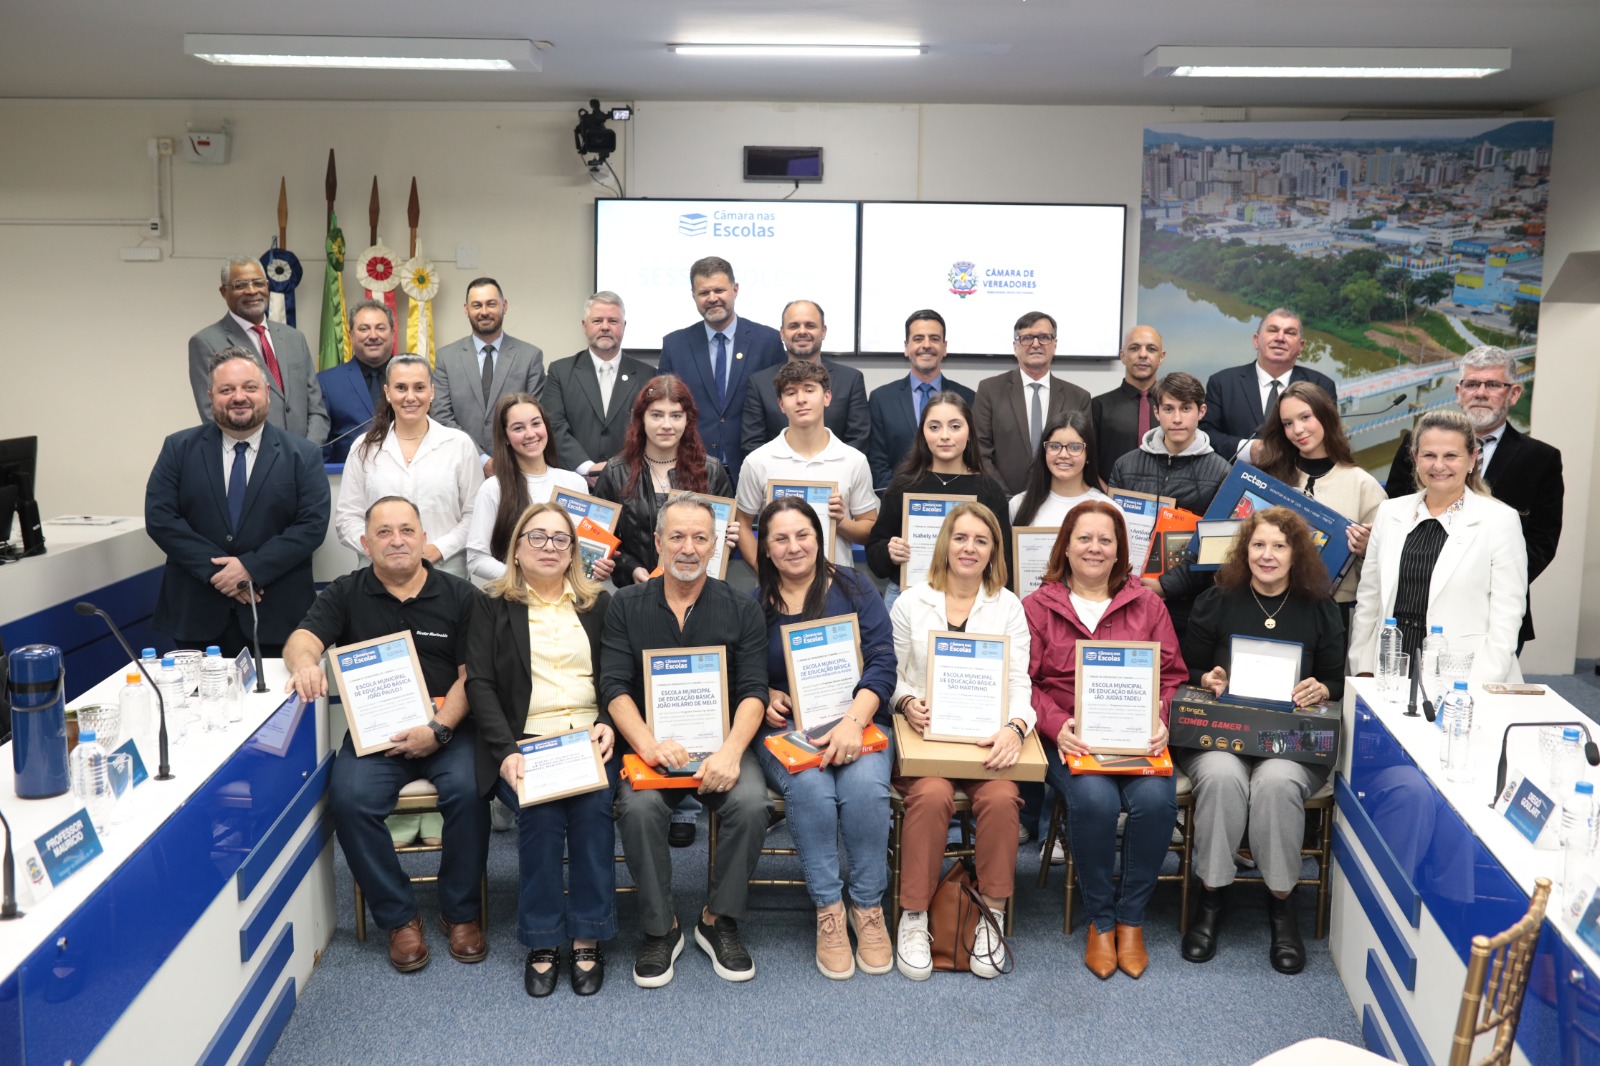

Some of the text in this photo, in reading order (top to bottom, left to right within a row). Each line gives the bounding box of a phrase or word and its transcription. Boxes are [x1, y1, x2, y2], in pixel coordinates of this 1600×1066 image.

[713, 209, 775, 220] Câmara nas
[713, 222, 774, 237] Escolas
[985, 268, 1034, 278] CÂMARA DE
[982, 280, 1037, 288] VEREADORES
[1241, 472, 1268, 490] pctop
[1163, 510, 1173, 519] fire
[582, 519, 592, 530] fire
[803, 636, 824, 644] Escolas
[353, 654, 377, 664] Escolas
[821, 658, 847, 666] MUNICIPAL
[808, 666, 833, 676] EDUCAÇÃO
[834, 662, 851, 670] BÁSICA
[355, 681, 377, 690] ESCOLA
[377, 673, 406, 684] MUNICIPAL
[362, 682, 391, 696] EDUCAÇÃO
[392, 678, 411, 686] BÁSICA
[367, 691, 381, 699] JOÃO
[382, 688, 398, 696] PAULO
[666, 694, 695, 702] EDUCAÇÃO
[1178, 717, 1209, 727] COMBO
[1211, 721, 1242, 731] GAMER
[1527, 791, 1541, 808] DIEGO
[1520, 797, 1540, 818] GOULART
[45, 819, 84, 851] PROFESSOR
